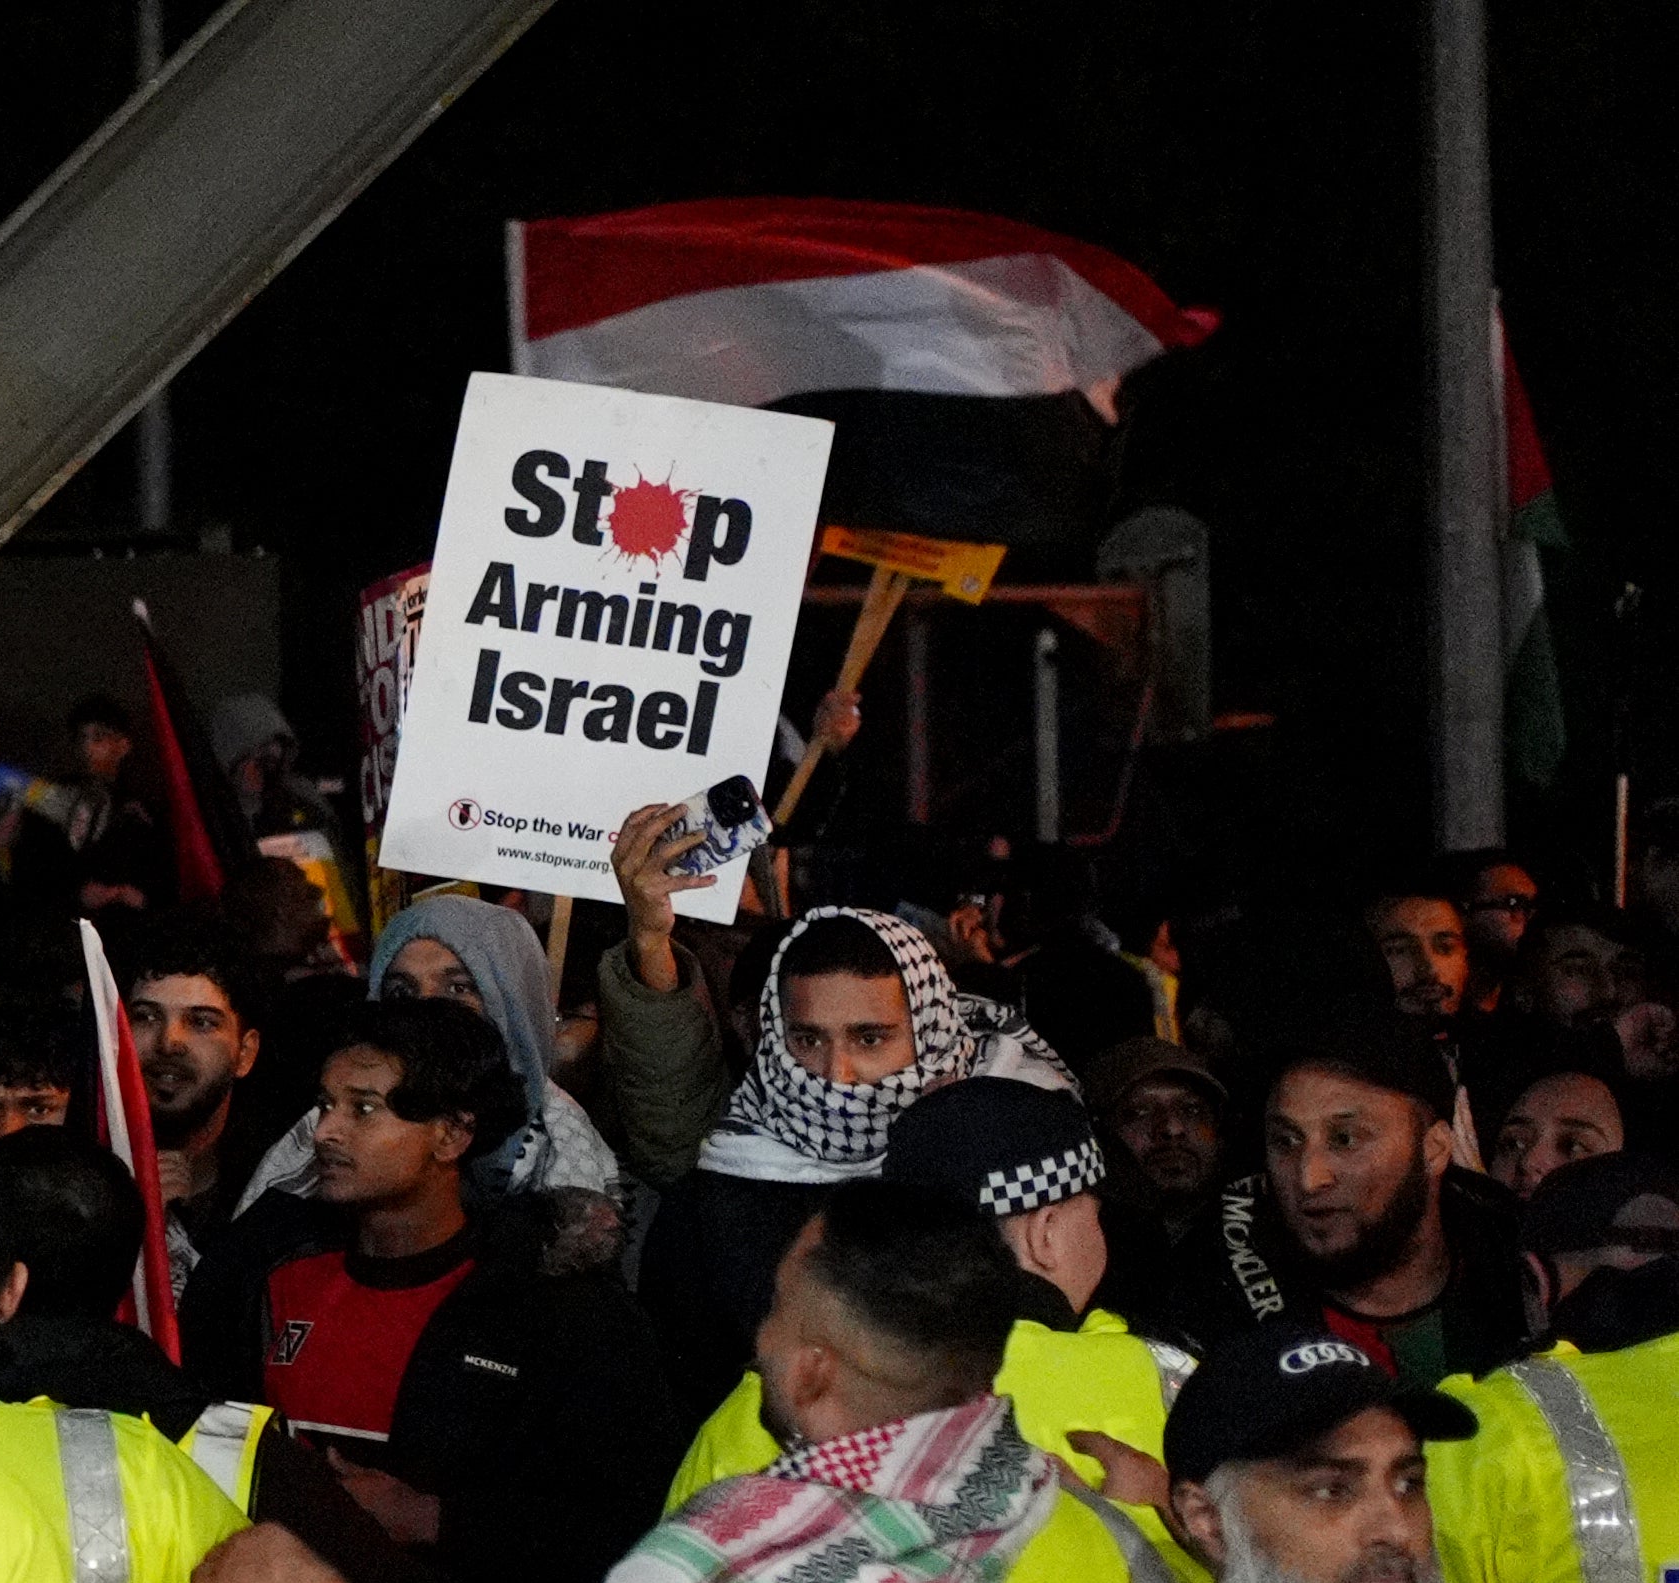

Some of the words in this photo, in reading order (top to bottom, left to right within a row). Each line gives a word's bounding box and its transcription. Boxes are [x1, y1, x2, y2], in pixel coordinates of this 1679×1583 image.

[465, 561, 752, 678] Arming
[467, 649, 720, 757] Israel
[483, 809, 528, 833] Stop
[532, 817, 562, 836] the
[568, 821, 604, 841] War
[496, 846, 613, 875] www.stopwar.org.
[463, 1353, 519, 1377] MCKENZIE
